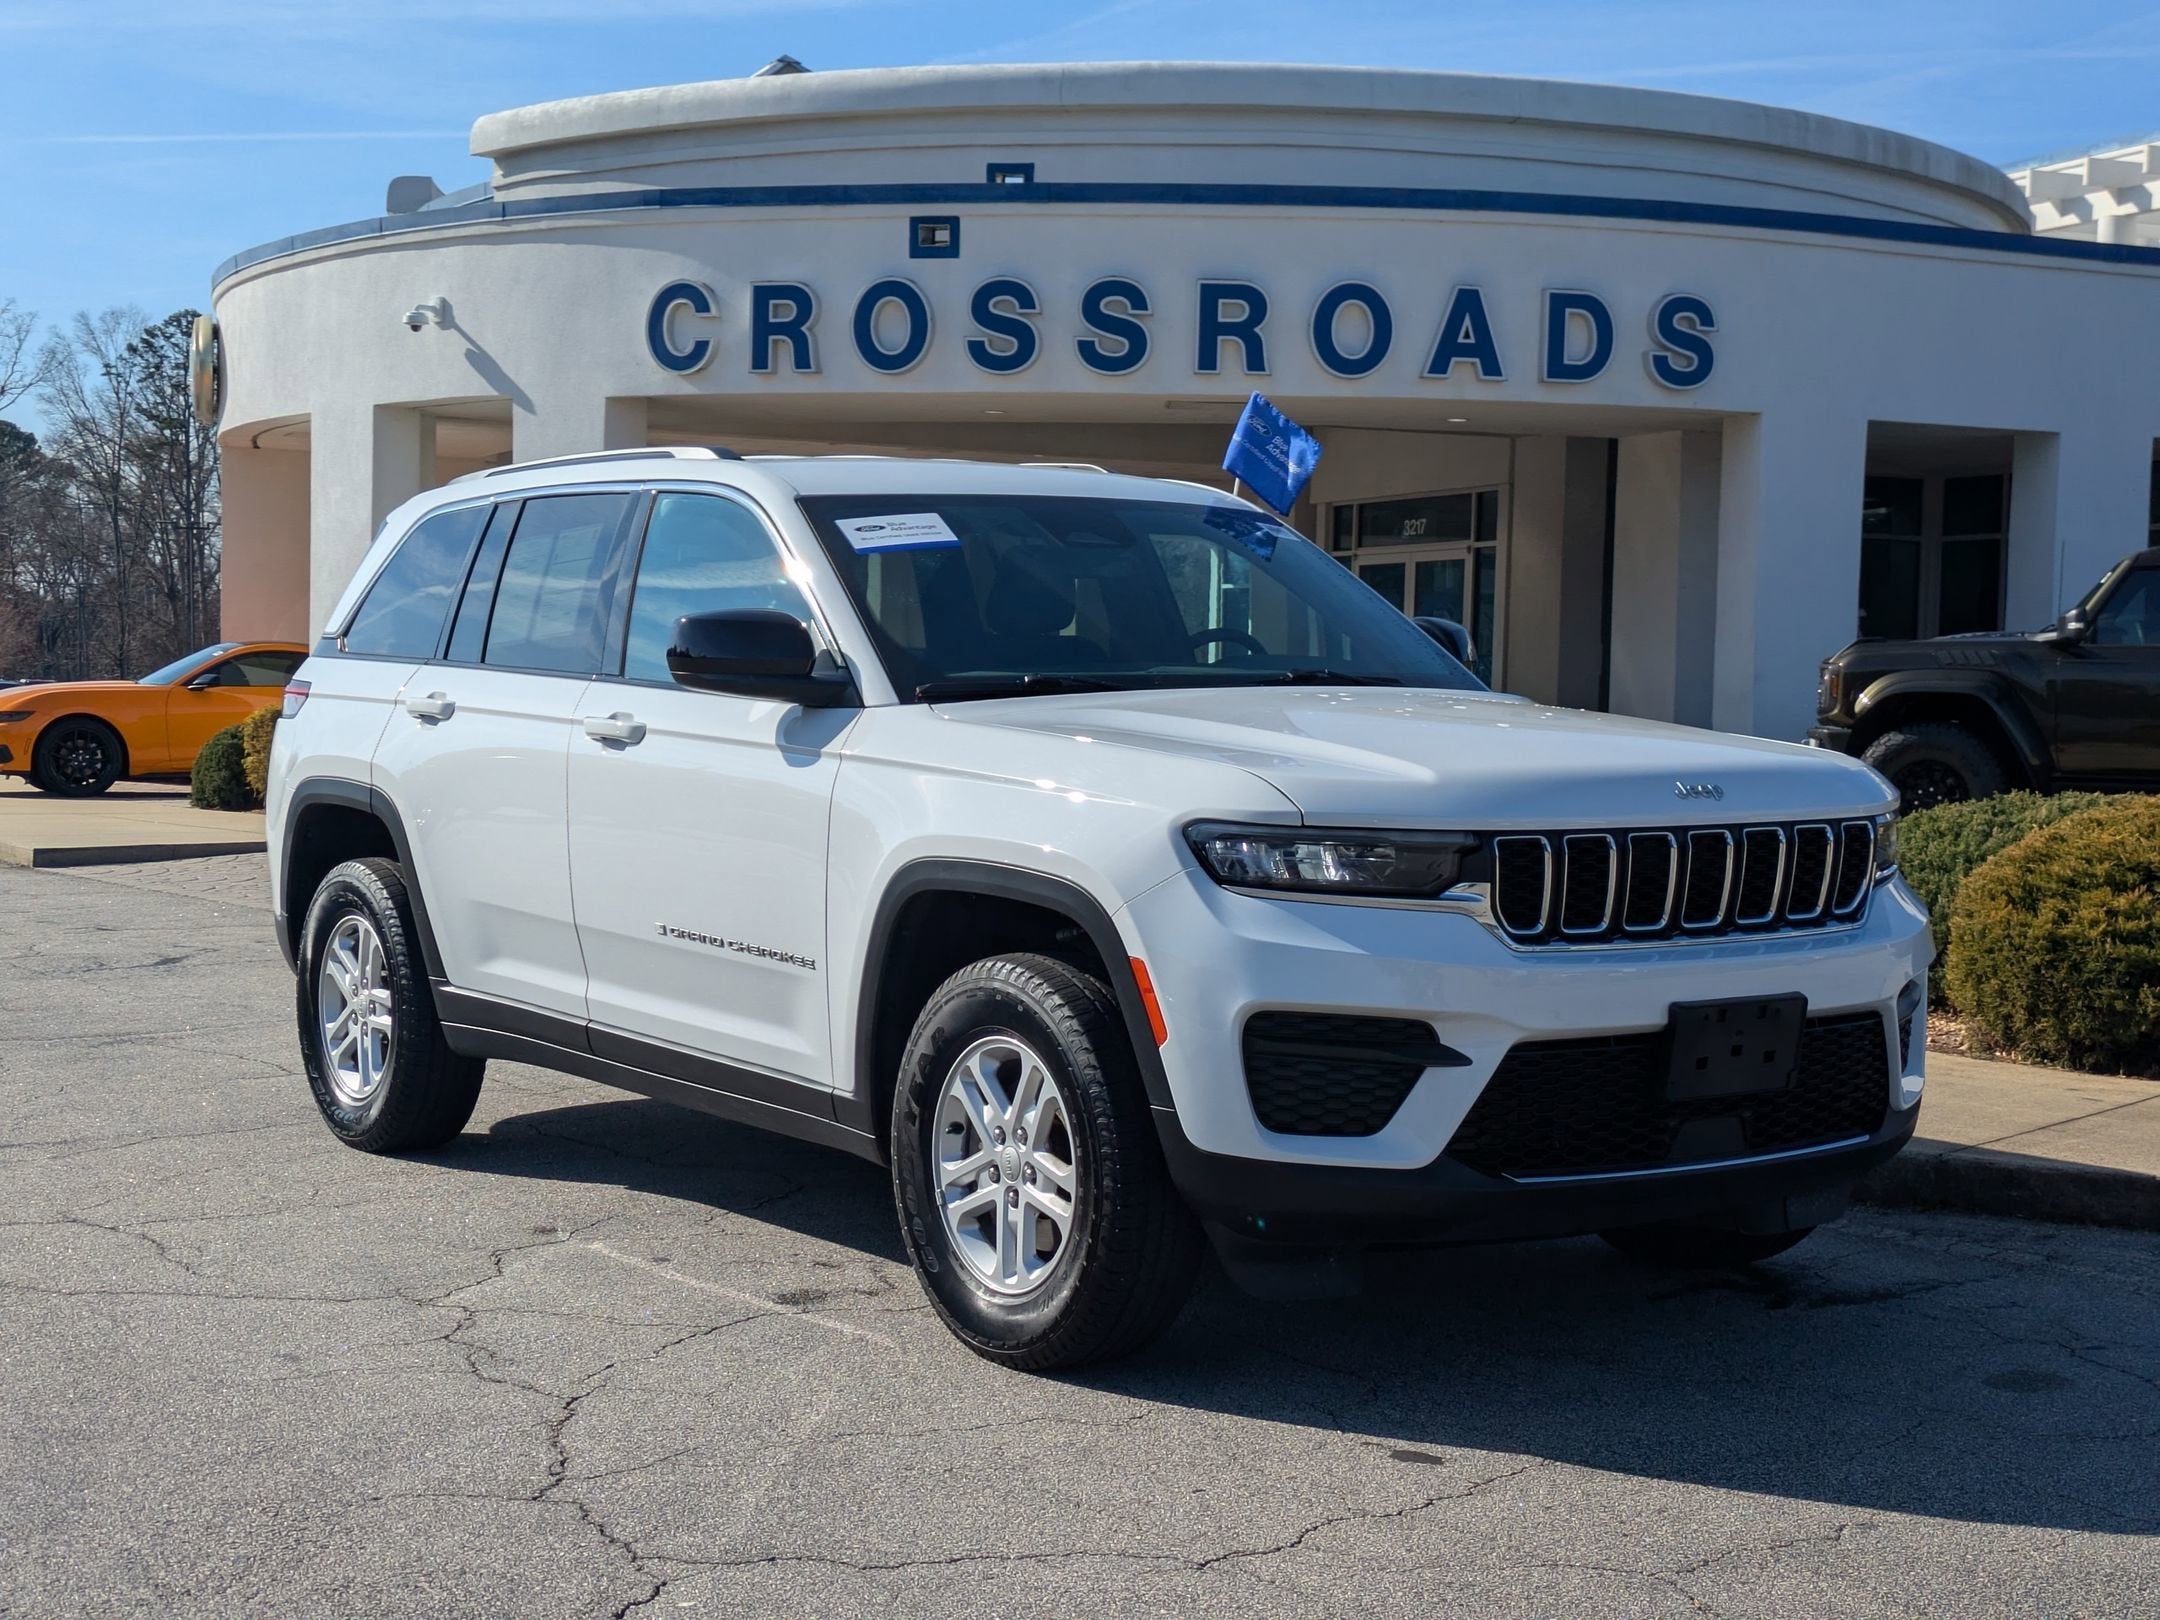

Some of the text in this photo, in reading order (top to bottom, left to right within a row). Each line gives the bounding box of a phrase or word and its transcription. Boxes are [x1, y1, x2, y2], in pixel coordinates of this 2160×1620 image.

[646, 275, 1719, 391] CROSSROADS
[1403, 518, 1428, 536] 3217
[1673, 781, 1724, 802] Jeep
[669, 926, 817, 971] GRAND CHEROKEE
